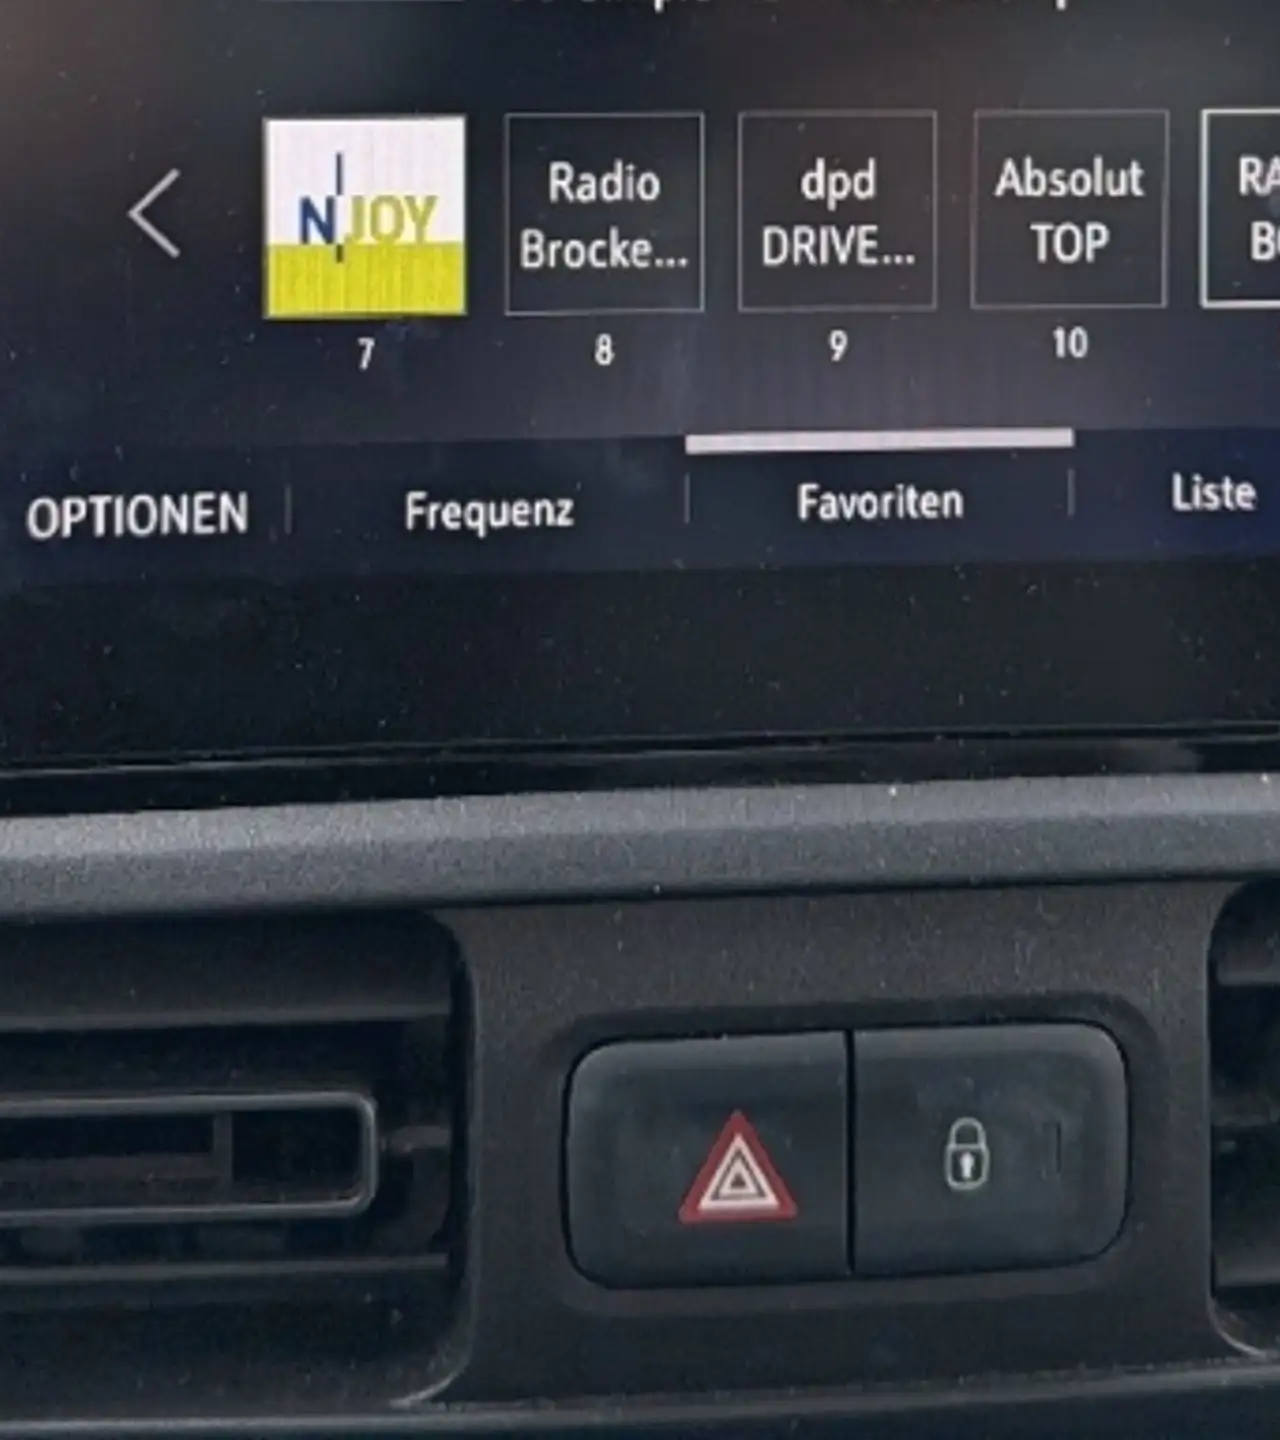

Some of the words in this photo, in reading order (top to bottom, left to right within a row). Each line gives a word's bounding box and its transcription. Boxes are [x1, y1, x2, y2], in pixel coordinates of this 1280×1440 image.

[549, 159, 661, 203] Radio
[801, 157, 876, 211] dpd
[994, 156, 1144, 197] Absolut
[521, 226, 688, 269] Brocke...
[762, 224, 915, 266] DRIVE...
[1029, 222, 1110, 263] TOP
[358, 337, 375, 370] 7
[594, 333, 615, 366] 8
[829, 329, 848, 362] 9
[1053, 326, 1088, 358] 10
[798, 482, 964, 521] Favoriten
[1172, 472, 1257, 511] Liste
[27, 491, 247, 539] OPTIONEN
[406, 491, 574, 537] Frequenz
